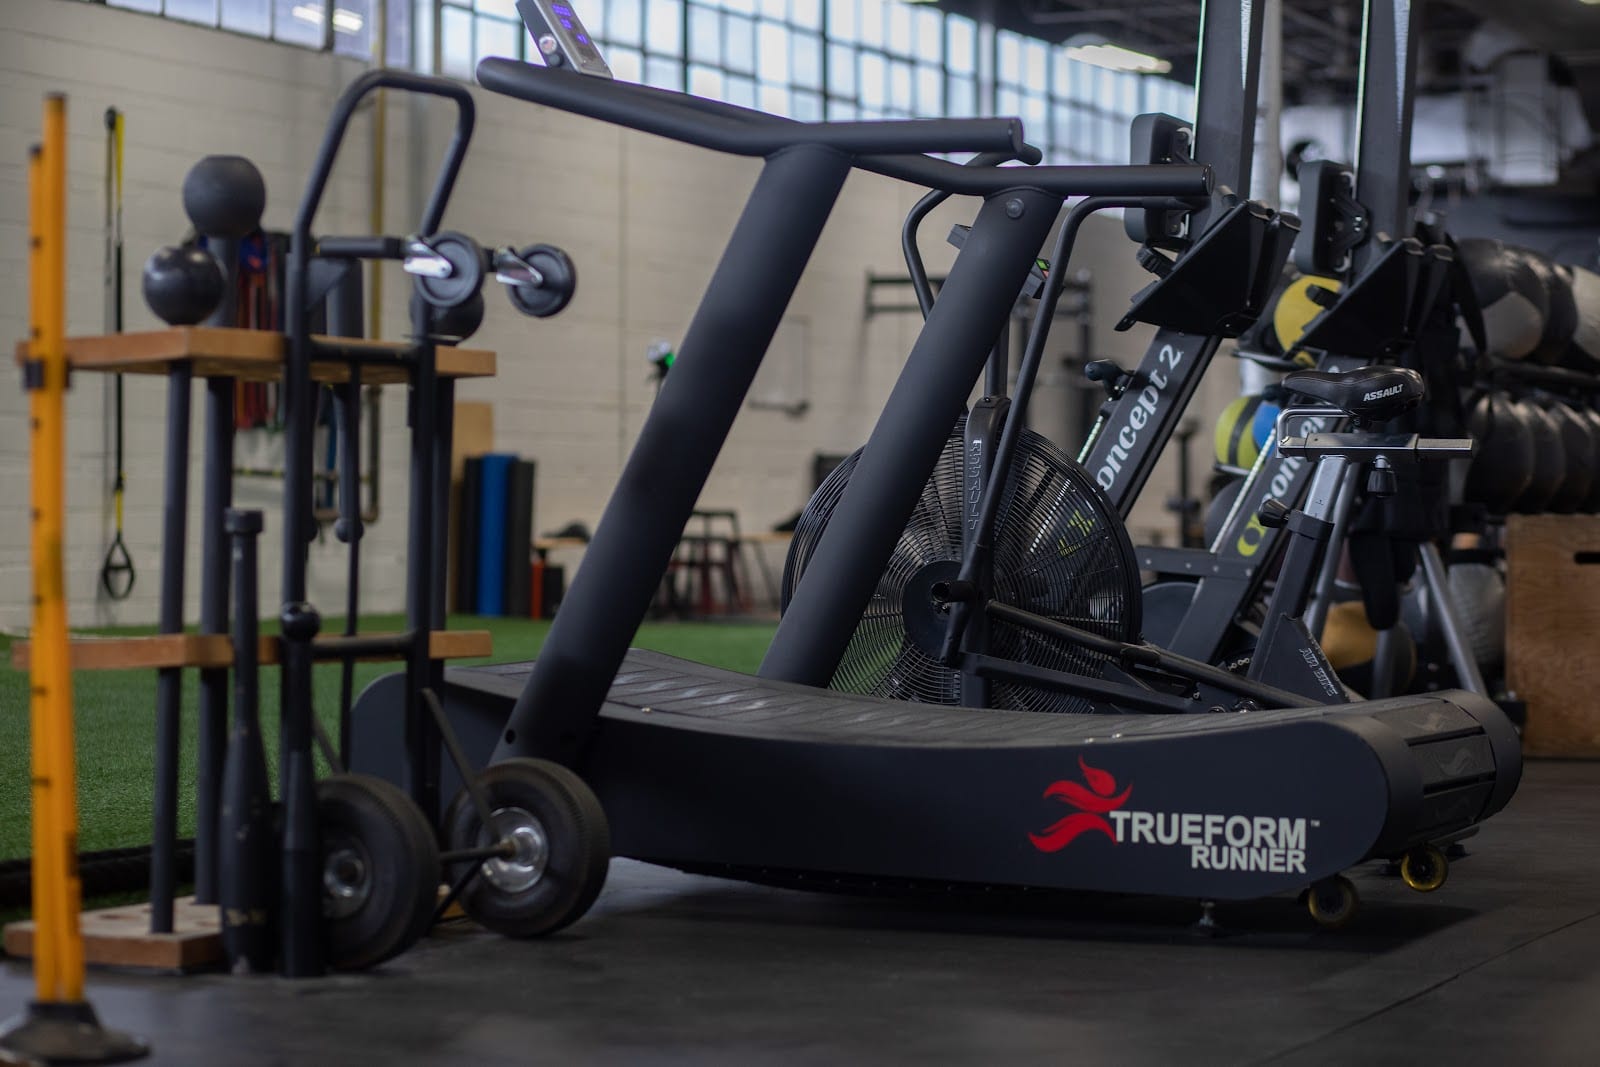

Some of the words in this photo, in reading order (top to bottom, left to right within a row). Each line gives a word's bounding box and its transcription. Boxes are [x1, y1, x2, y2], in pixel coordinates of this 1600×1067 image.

[1363, 384, 1404, 401] ASSAULT
[1096, 368, 1168, 491] oncept
[1159, 343, 1184, 370] 2
[1109, 810, 1306, 850] TRUEFORM
[1191, 845, 1307, 873] RUNNER
